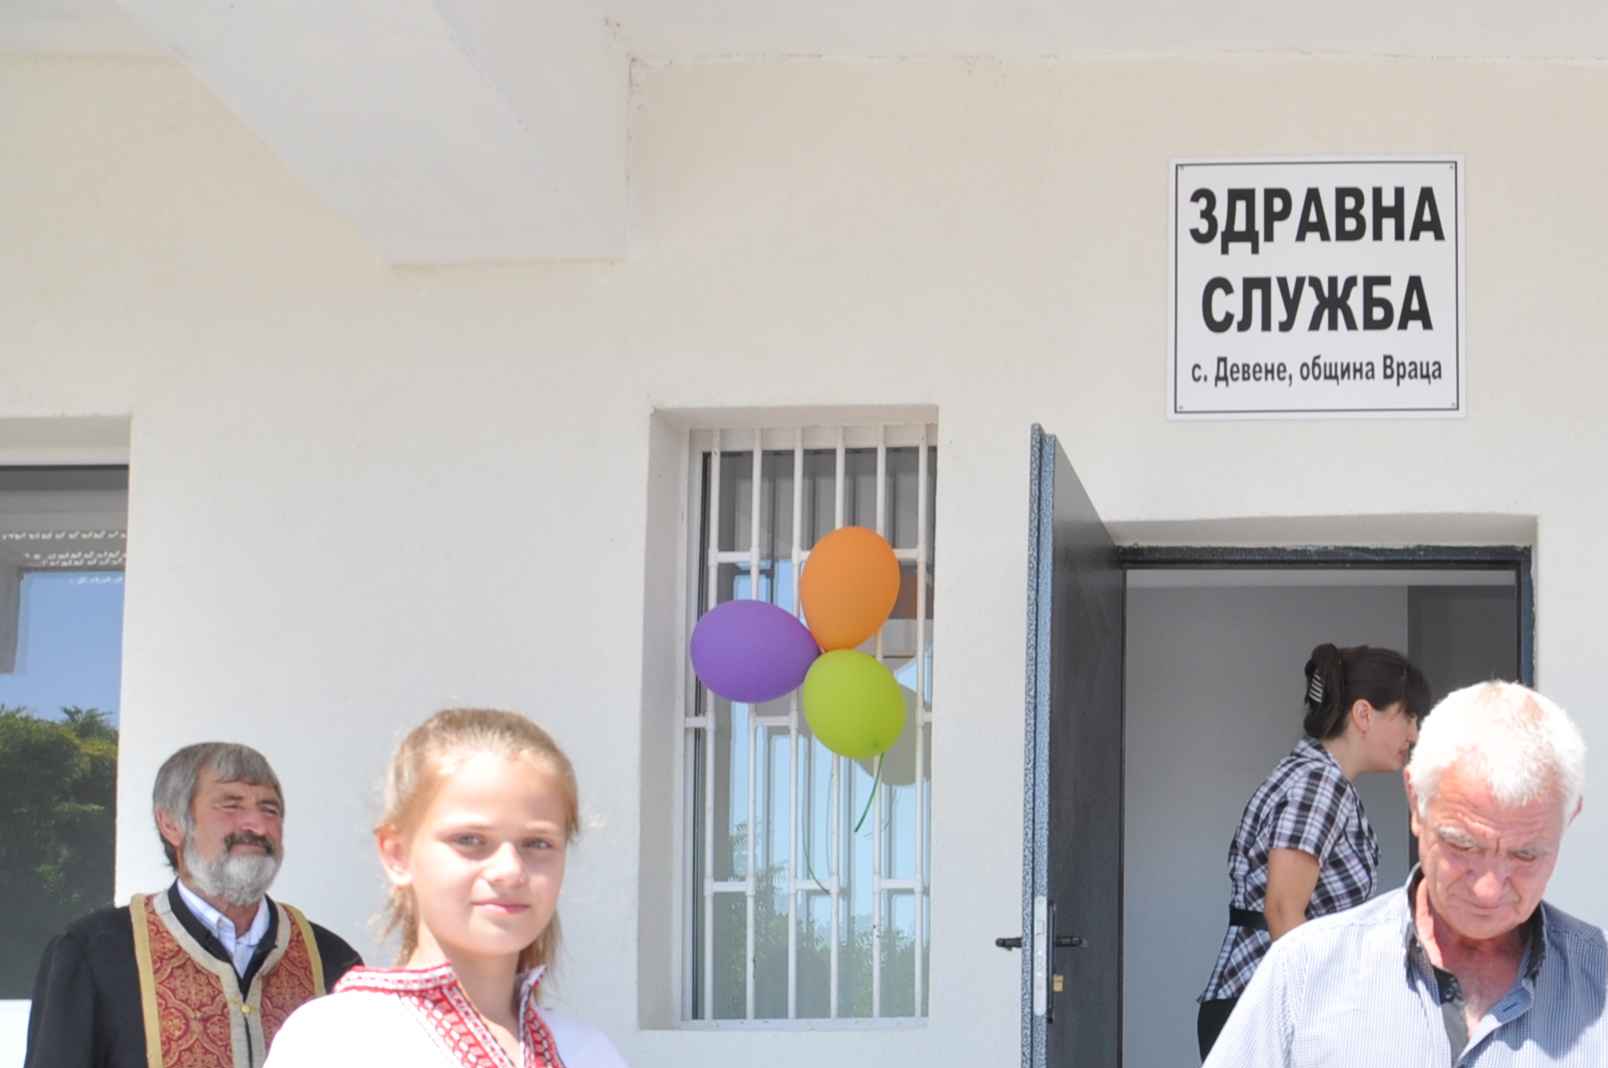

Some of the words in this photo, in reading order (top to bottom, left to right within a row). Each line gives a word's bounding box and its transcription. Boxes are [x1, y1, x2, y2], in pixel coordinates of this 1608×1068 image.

[1189, 186, 1446, 255] ЗДРАВНА
[1201, 275, 1434, 333] СЛУЖБА
[1191, 362, 1208, 382] с.
[1214, 356, 1293, 387] Девене,
[1299, 354, 1375, 386] община
[1382, 354, 1443, 387] Враца
